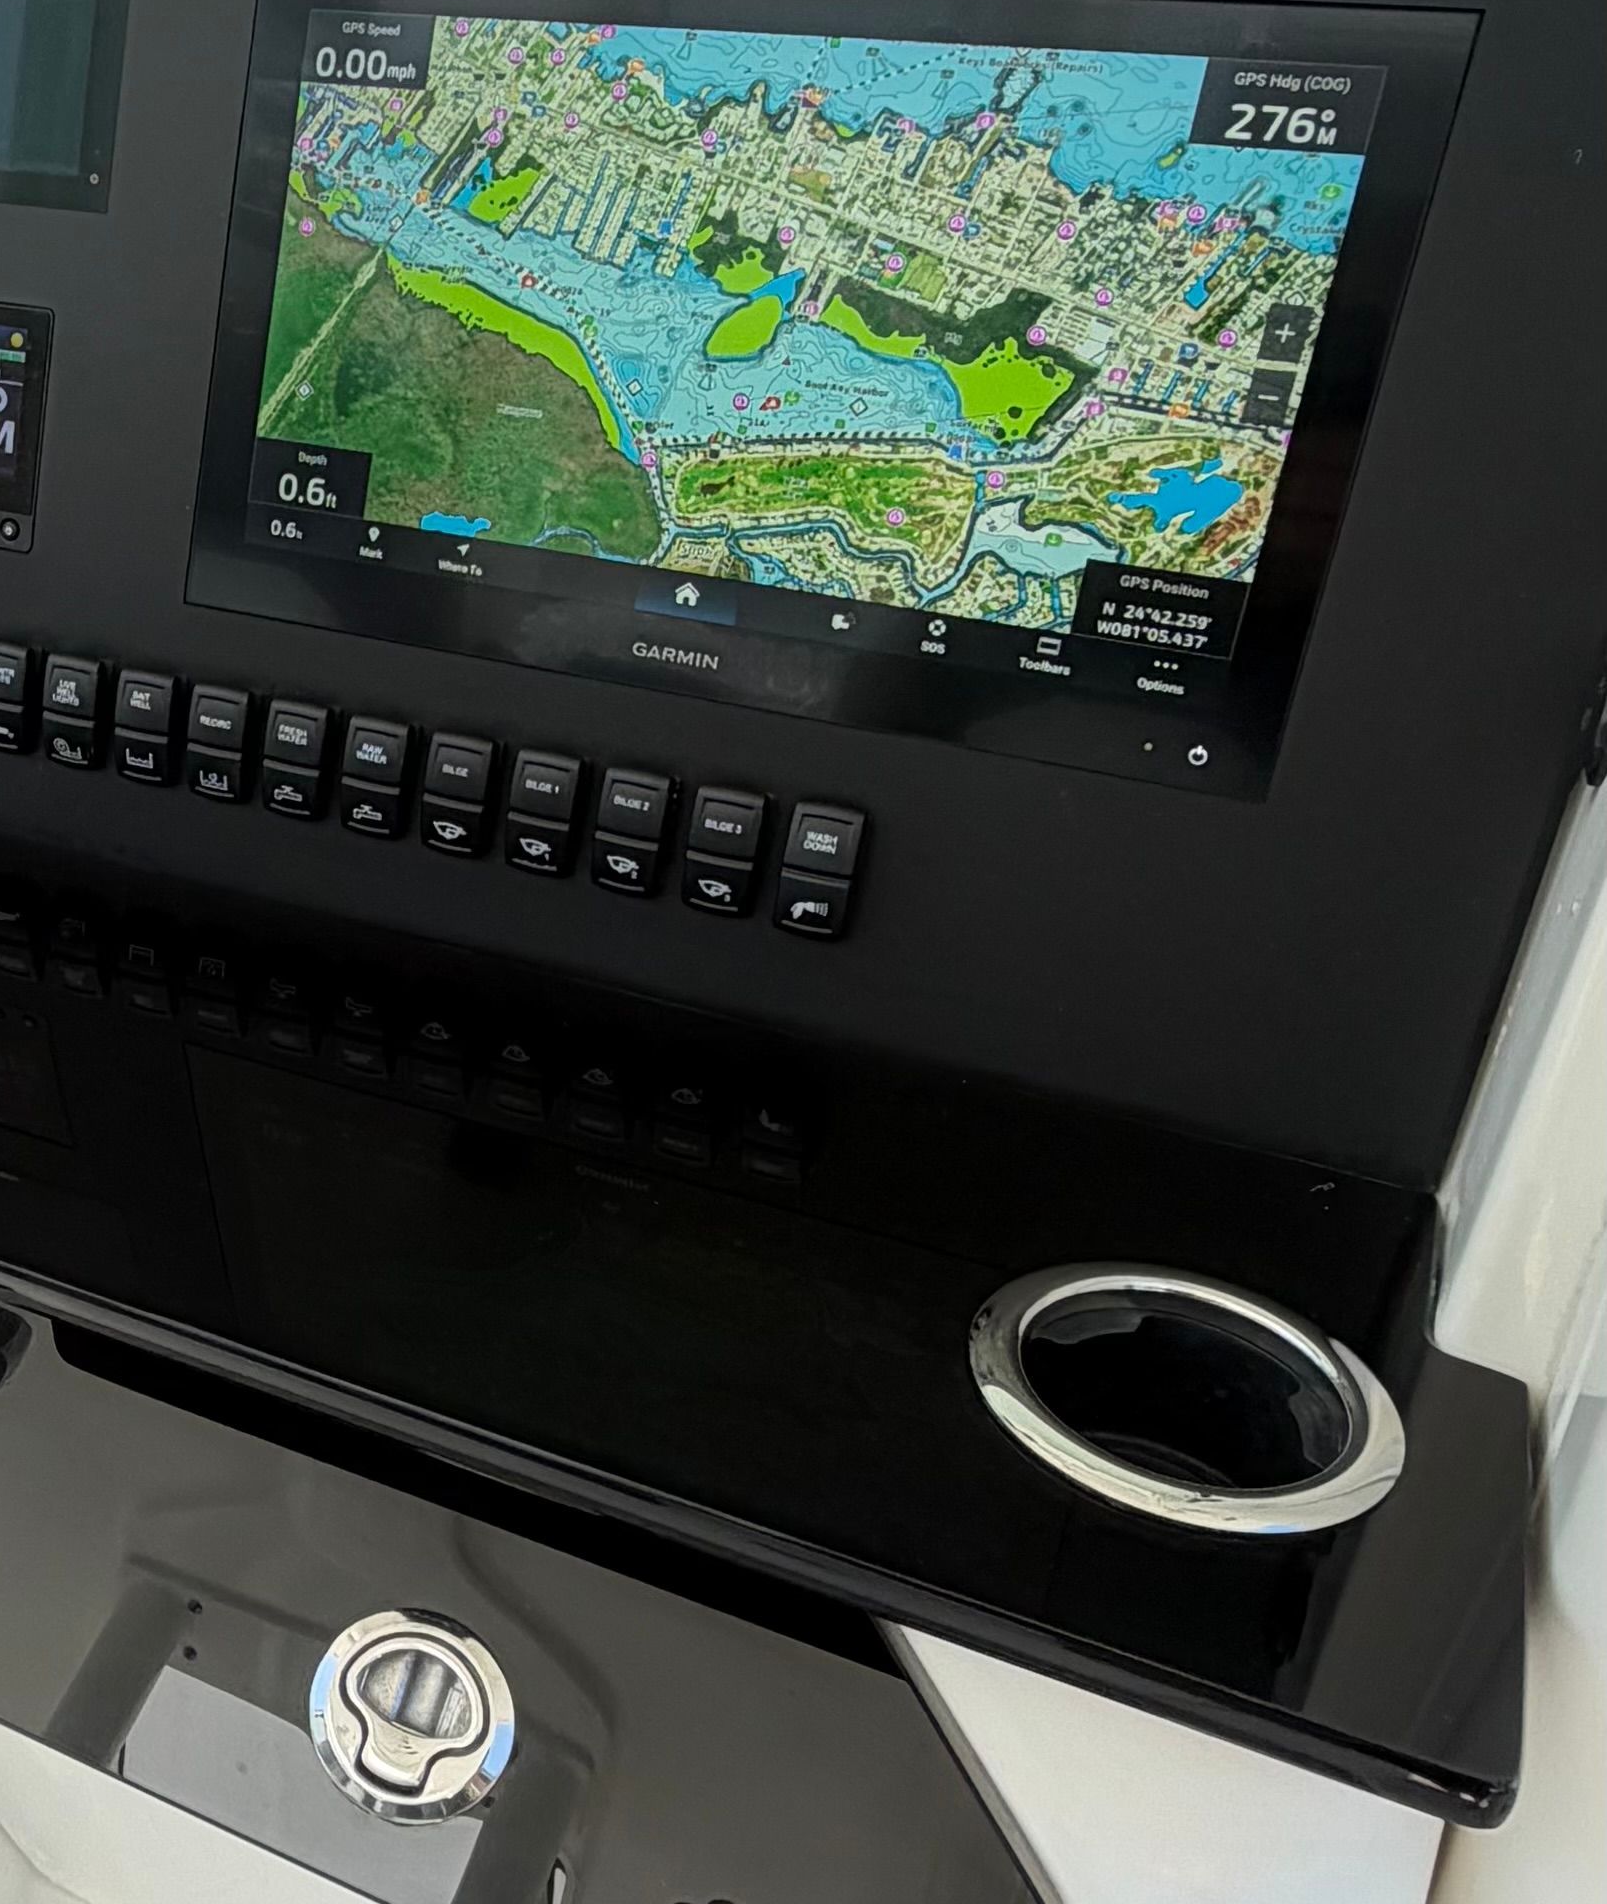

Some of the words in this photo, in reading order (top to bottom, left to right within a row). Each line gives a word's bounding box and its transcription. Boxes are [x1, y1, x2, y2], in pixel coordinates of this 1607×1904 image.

[342, 21, 365, 34] GPS
[367, 24, 401, 37] Speed
[1233, 71, 1268, 89] GPS
[1271, 73, 1298, 94] Hdg
[1302, 74, 1352, 96] (COG)
[298, 451, 328, 467] Depth
[359, 546, 383, 559] Mark
[438, 559, 468, 574] Where
[470, 561, 482, 576] To
[1119, 572, 1150, 590] GPS
[1152, 578, 1210, 599] Position
[1102, 601, 1115, 616] N
[920, 640, 946, 655] SOS
[632, 642, 719, 670] GARMIN
[1019, 656, 1071, 677] Toolbars
[59, 679, 76, 690] LIVE
[1137, 676, 1185, 697] Options
[52, 693, 80, 707] LIGHTS
[56, 686, 76, 699] WELL
[132, 690, 150, 702] BAIT
[130, 698, 151, 711] WELL
[199, 714, 232, 731] RECIRC
[278, 723, 308, 737] FRESH
[277, 731, 308, 746] WATER
[362, 742, 383, 755] RAW
[356, 749, 387, 765] WATER
[442, 764, 469, 777] BILGE
[525, 779, 552, 793] BILGE
[613, 794, 642, 809] BILGE
[704, 818, 734, 833] BILGE
[806, 831, 838, 845] WASH
[803, 839, 837, 855] DOWN
